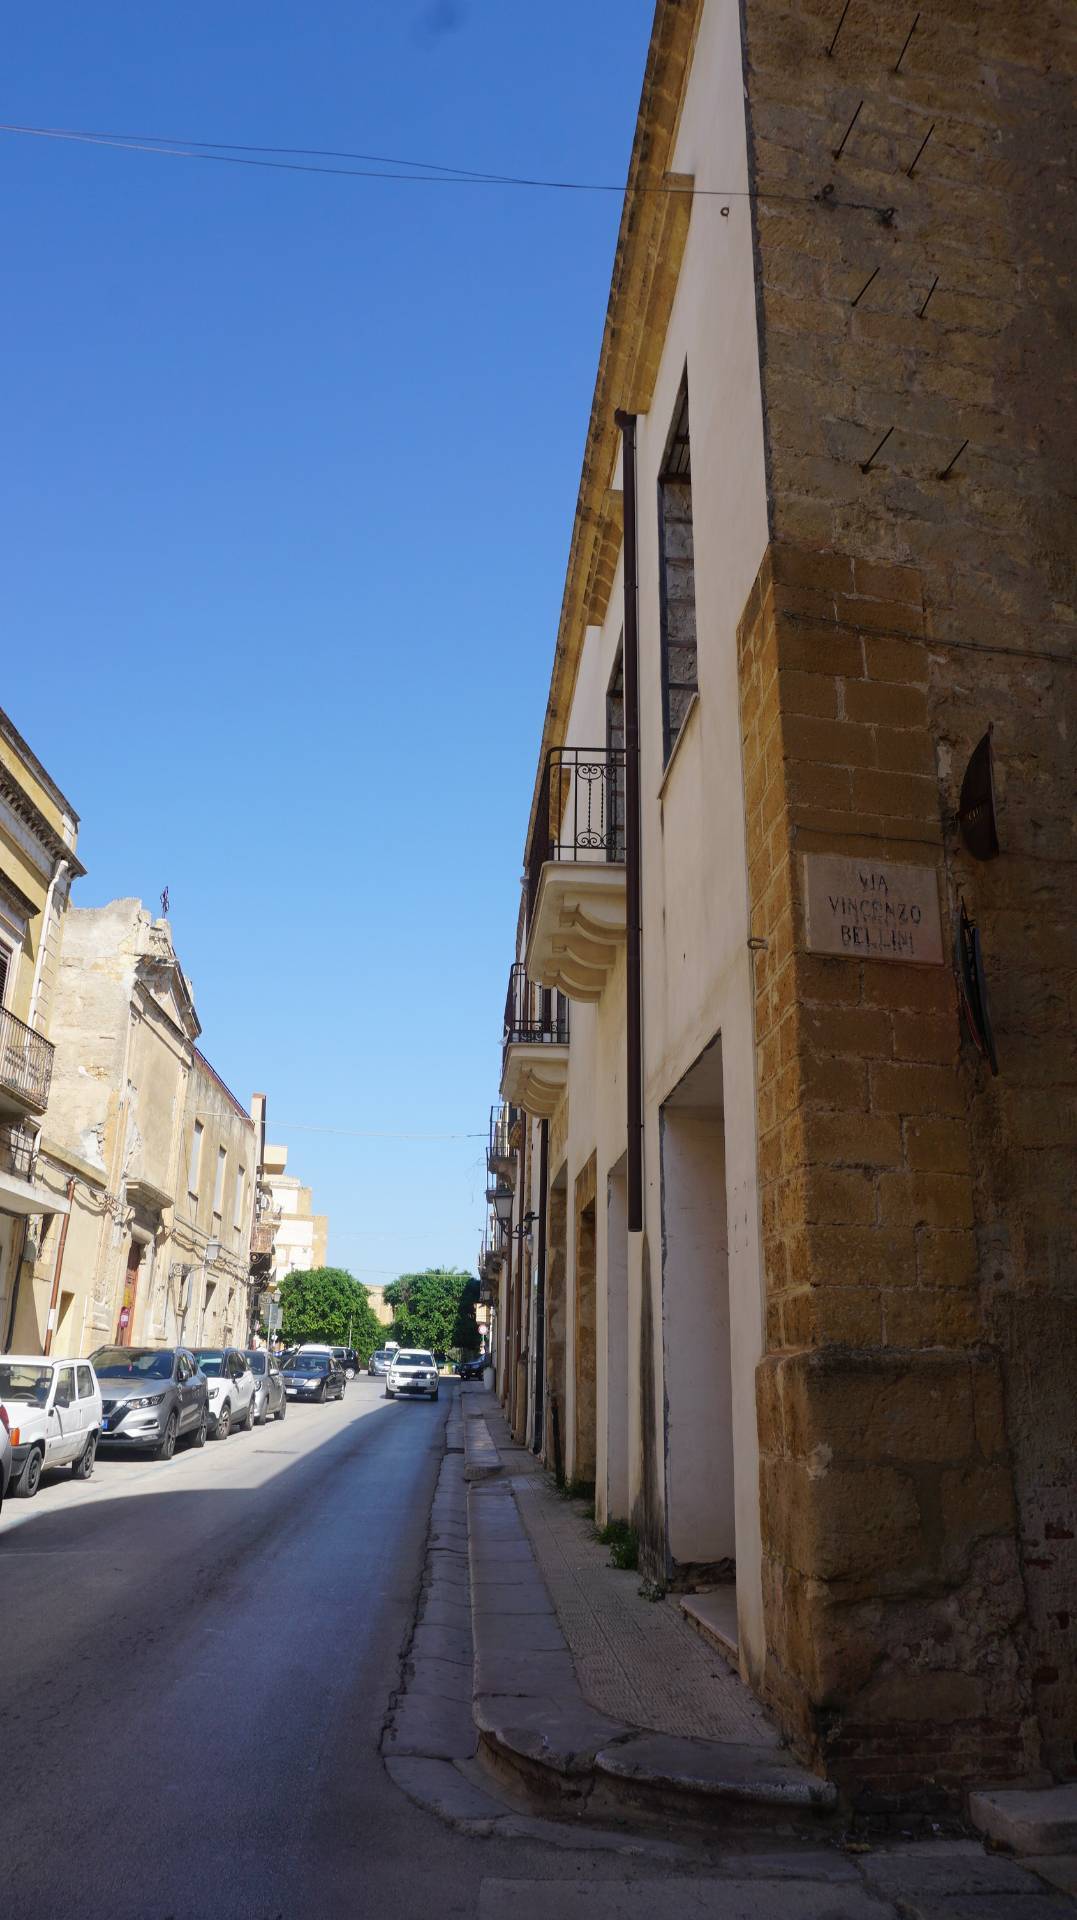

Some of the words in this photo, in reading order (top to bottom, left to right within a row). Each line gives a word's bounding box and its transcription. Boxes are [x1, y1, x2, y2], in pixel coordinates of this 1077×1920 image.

[859, 872, 888, 895] VIA
[828, 896, 921, 926] VINCENZO
[841, 925, 915, 954] BELLINI
